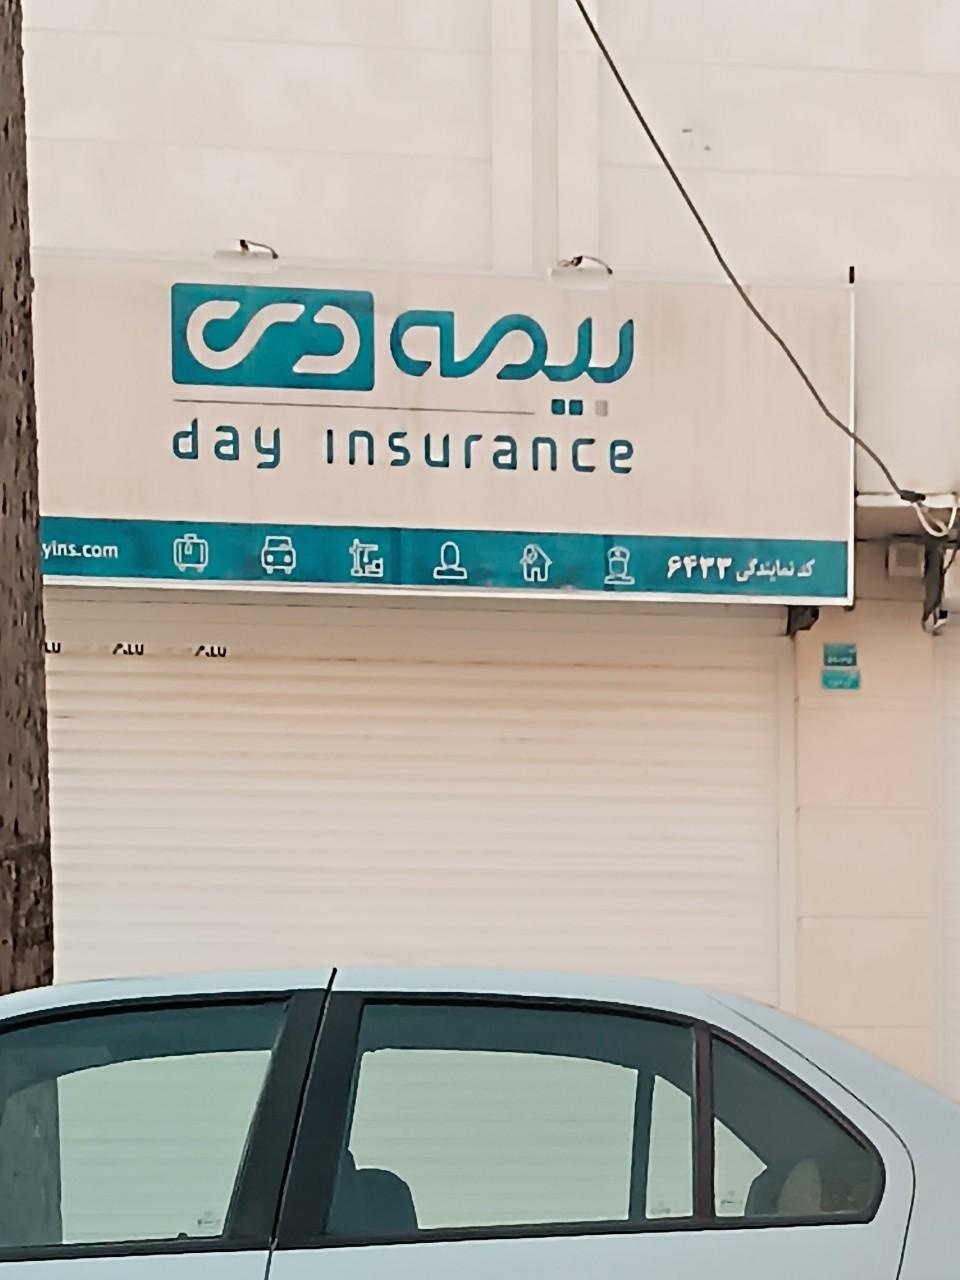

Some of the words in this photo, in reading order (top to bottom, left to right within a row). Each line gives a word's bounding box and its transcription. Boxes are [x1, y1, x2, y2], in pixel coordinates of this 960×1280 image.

[390, 310, 635, 417] بیمه
[172, 417, 281, 469] day
[326, 428, 635, 475] insurance
[42, 540, 119, 561] yins.com
[736, 557, 794, 583] نمایندگی
[797, 558, 816, 578] کد
